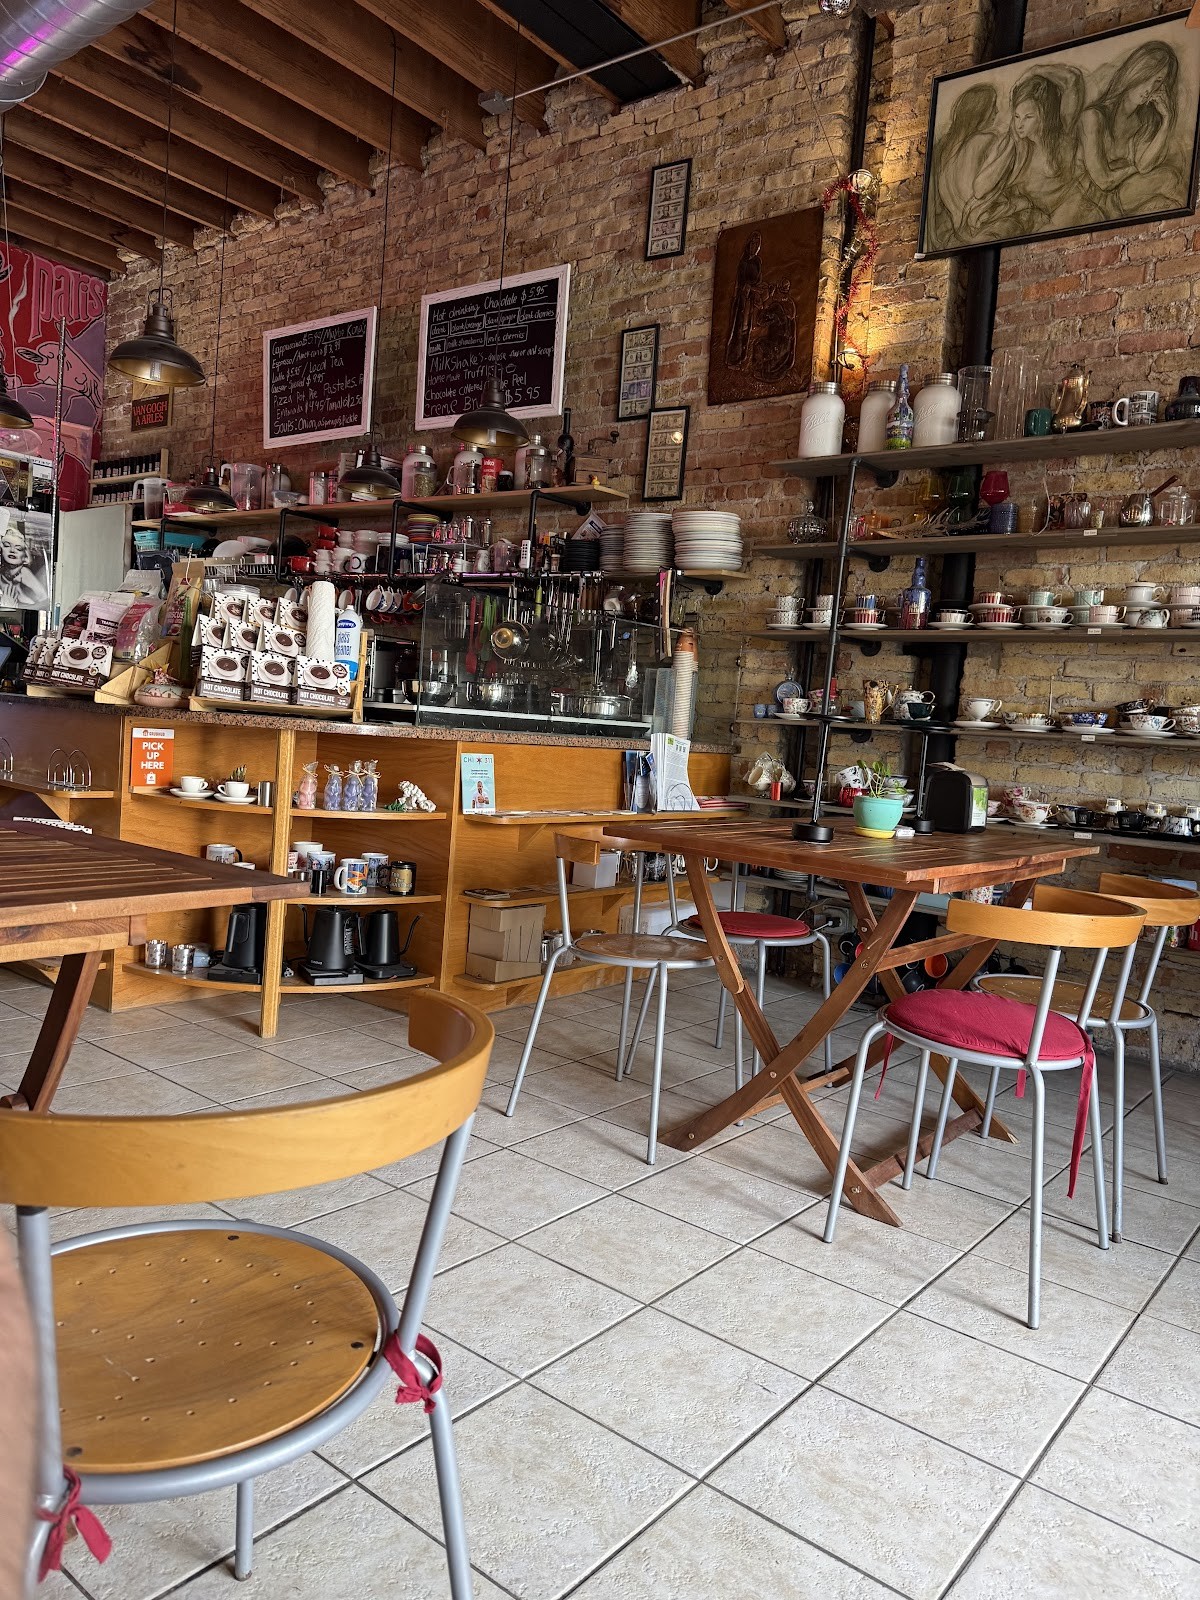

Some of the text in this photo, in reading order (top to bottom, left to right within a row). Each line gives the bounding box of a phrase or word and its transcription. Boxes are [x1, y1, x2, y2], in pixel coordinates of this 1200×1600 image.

[28, 251, 106, 344] paris
[432, 309, 446, 322] Hot
[449, 304, 480, 318] drinking
[330, 356, 344, 368] Tea
[425, 387, 456, 401] Chocolate
[274, 394, 292, 408] Pizza
[133, 400, 168, 416] VAN GOGH
[141, 412, 164, 425] ARLES
[60, 672, 84, 682] CHOCOLATE
[214, 685, 241, 695] CHOCOLATE
[254, 687, 263, 695] HOT
[263, 689, 289, 699] CHOCOLATE
[300, 691, 310, 699] HOT
[310, 693, 335, 703] CHOCOLATE
[142, 741, 164, 750] PICK
[147, 752, 160, 760] UP
[141, 761, 165, 770] HERE
